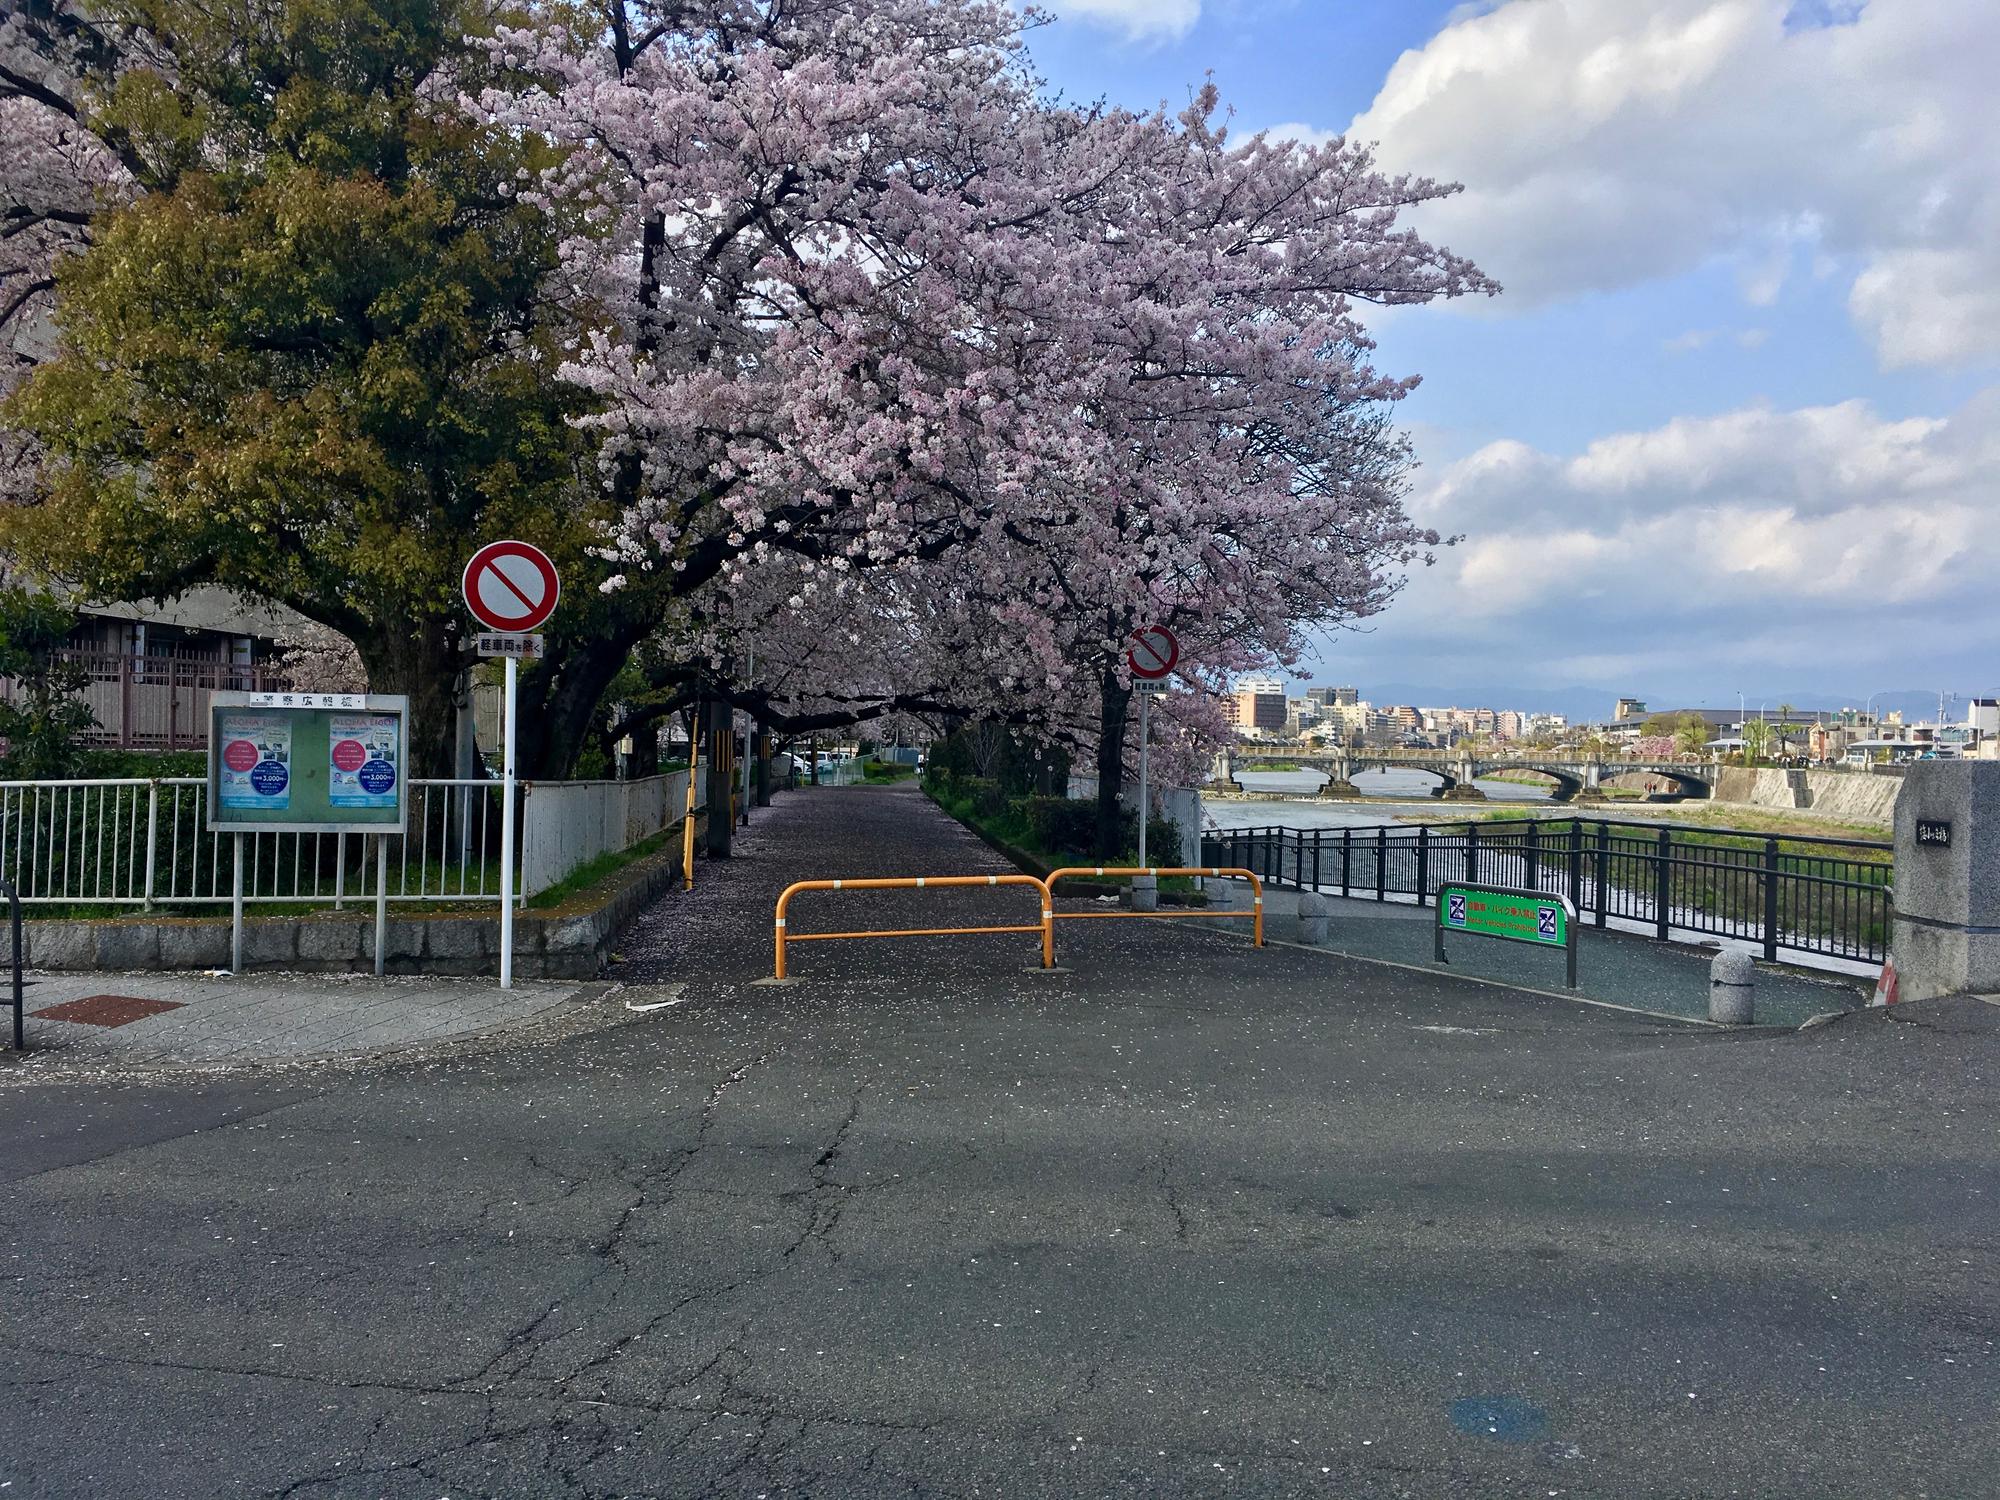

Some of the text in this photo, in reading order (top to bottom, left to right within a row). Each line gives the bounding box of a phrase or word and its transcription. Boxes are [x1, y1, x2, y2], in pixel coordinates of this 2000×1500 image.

[480, 639, 540, 652] 軽車両を除く
